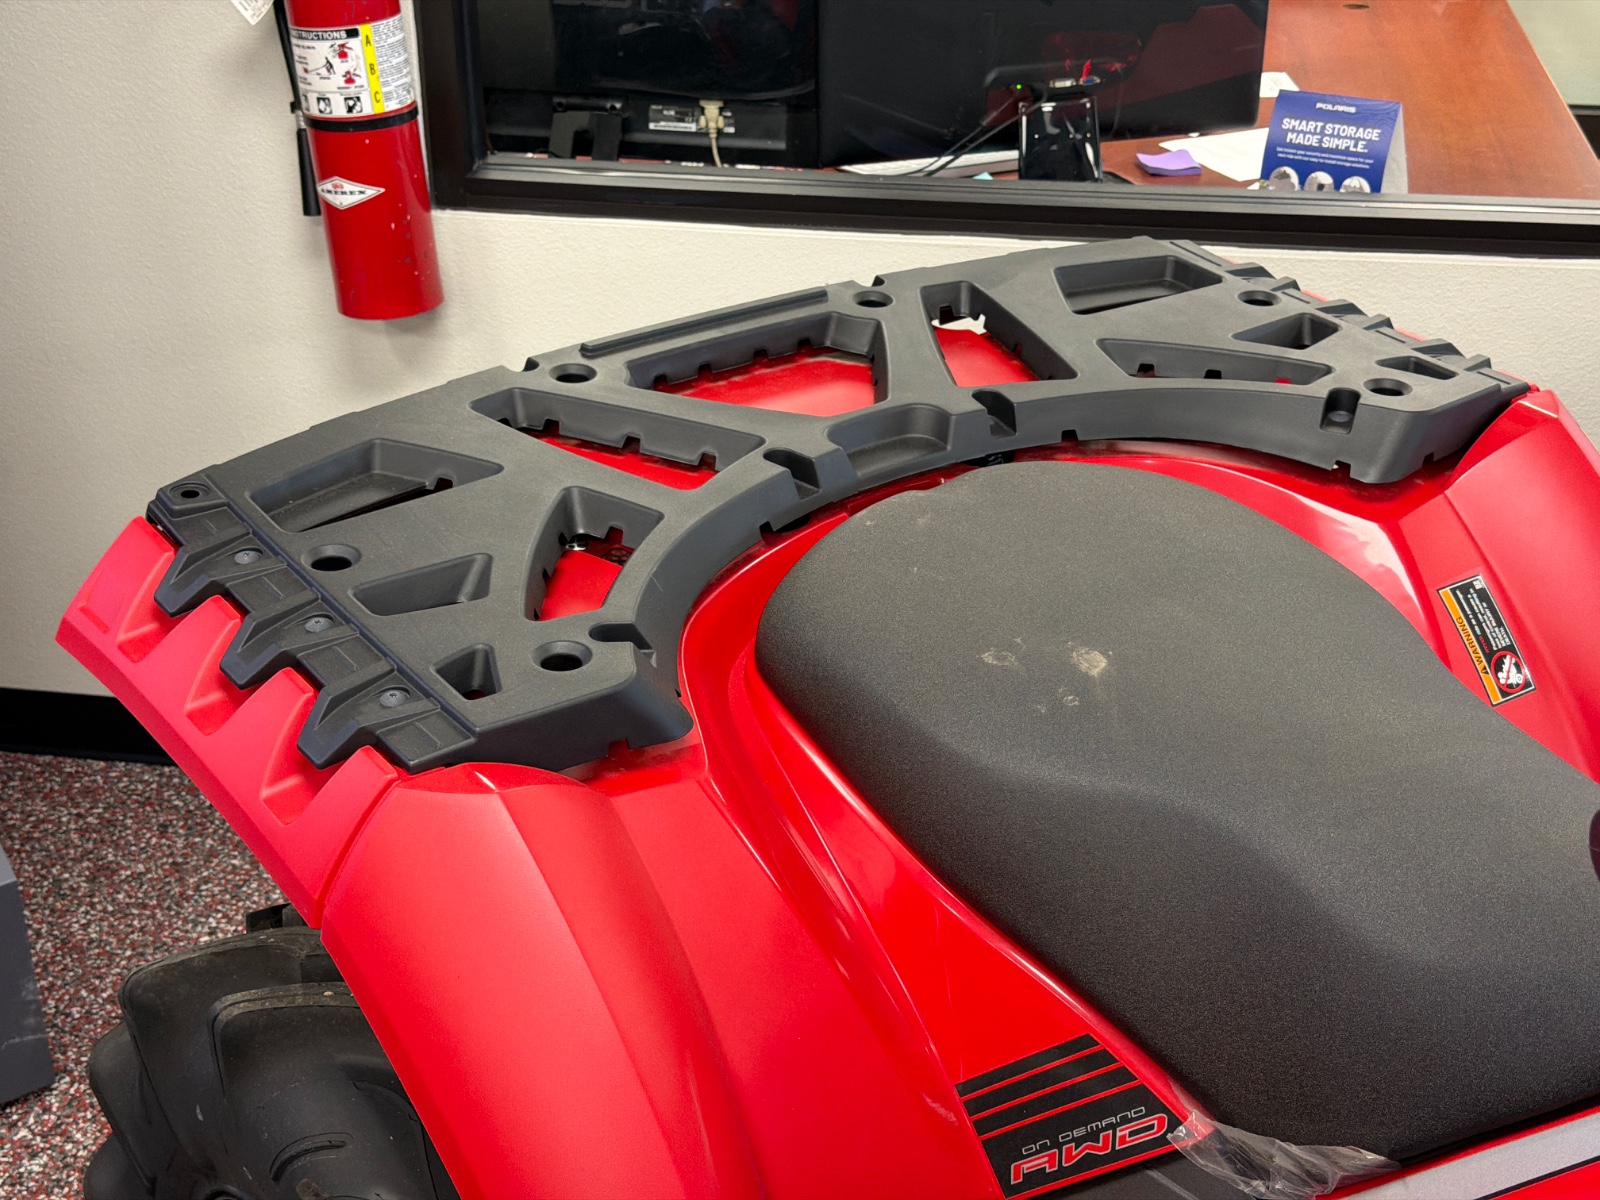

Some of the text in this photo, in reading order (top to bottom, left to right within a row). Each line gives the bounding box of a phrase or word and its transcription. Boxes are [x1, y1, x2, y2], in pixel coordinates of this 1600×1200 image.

[366, 35, 372, 47] A
[369, 64, 376, 75] B
[374, 91, 381, 103] C
[1316, 102, 1356, 113] POLARIS
[1282, 118, 1381, 140] SMART STORAGE
[1286, 132, 1368, 153] MADE SIMPLE.
[1456, 616, 1483, 664] WARNING
[1022, 1106, 1145, 1155] ON DEMAND
[1010, 1114, 1168, 1185] AWD
